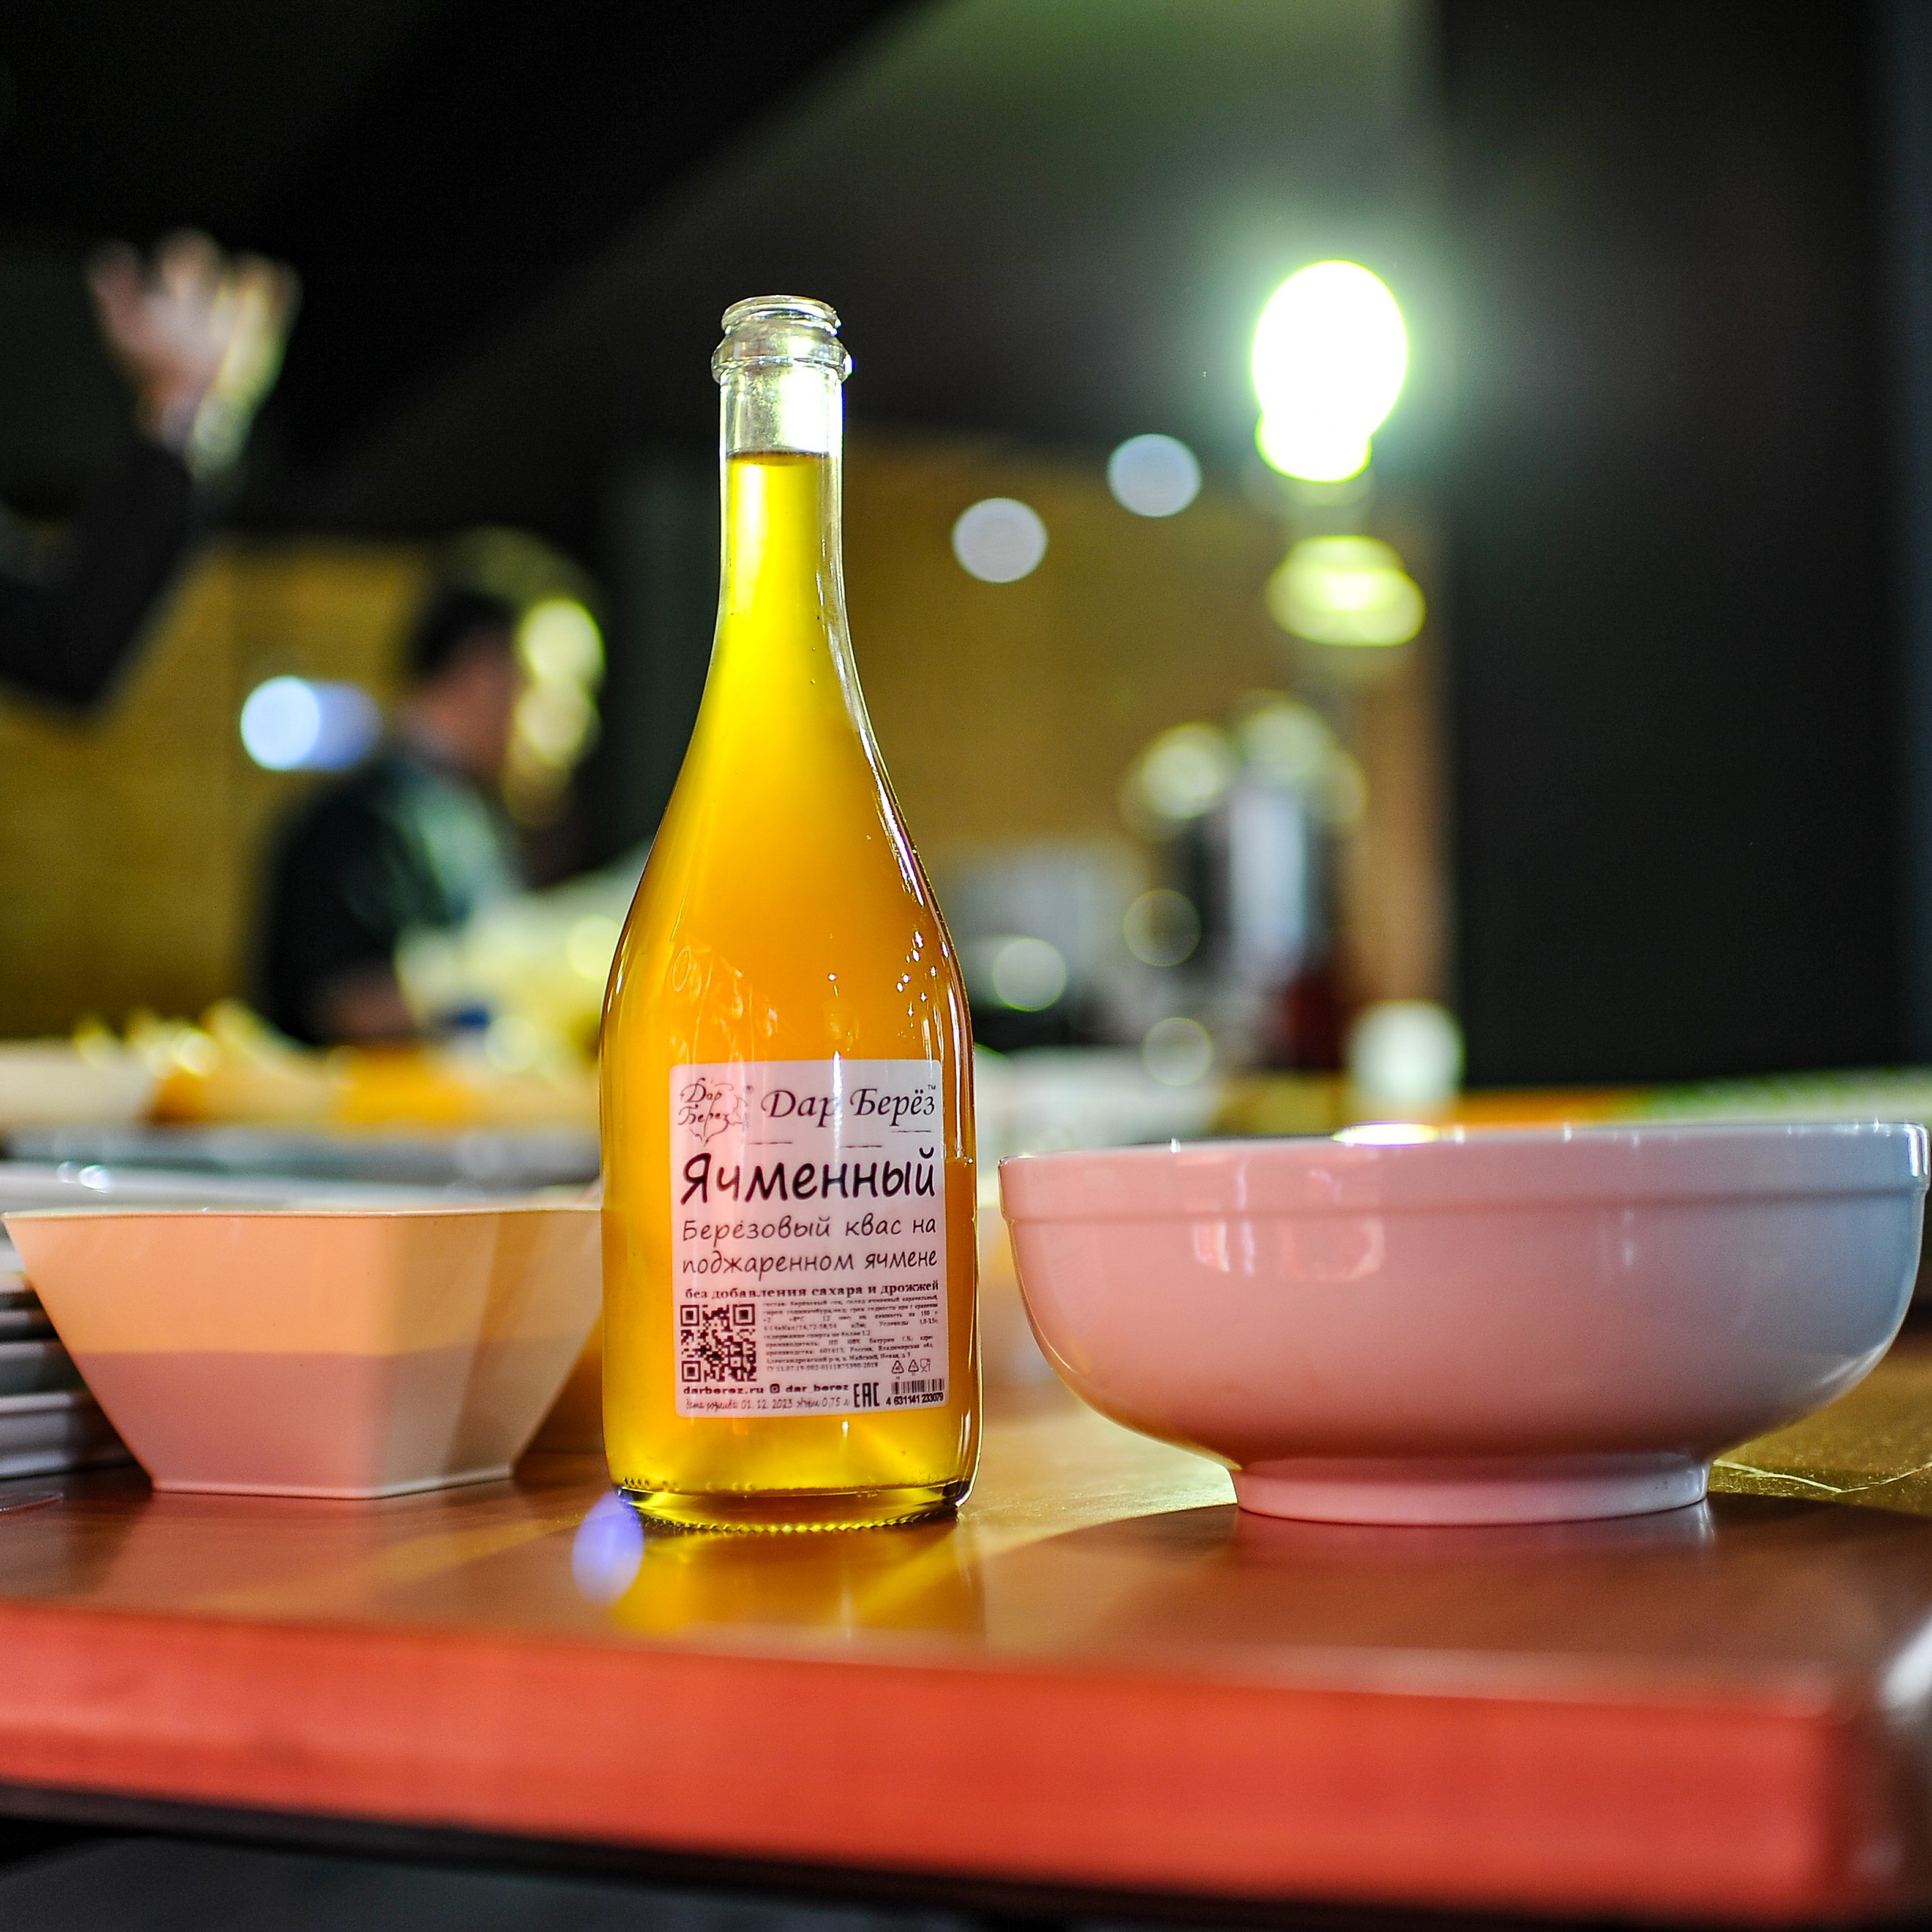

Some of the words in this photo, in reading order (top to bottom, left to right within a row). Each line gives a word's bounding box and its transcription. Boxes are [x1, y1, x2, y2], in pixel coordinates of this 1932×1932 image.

[761, 1090, 842, 1128] Дар
[850, 1088, 935, 1127] Берёз
[681, 1147, 935, 1205] Ячменный
[845, 1213, 901, 1236] квас
[912, 1218, 936, 1233] на
[683, 1250, 854, 1281] поджаренном
[865, 1250, 937, 1269] ячмене
[685, 1288, 708, 1298] без
[711, 1287, 806, 1300] добавления
[811, 1287, 863, 1297] сахара
[868, 1285, 876, 1294] и
[880, 1280, 939, 1296] дрожжей
[683, 1386, 764, 1394] darberez.ru
[772, 1398, 793, 1409] 2023
[885, 1396, 891, 1406] 4
